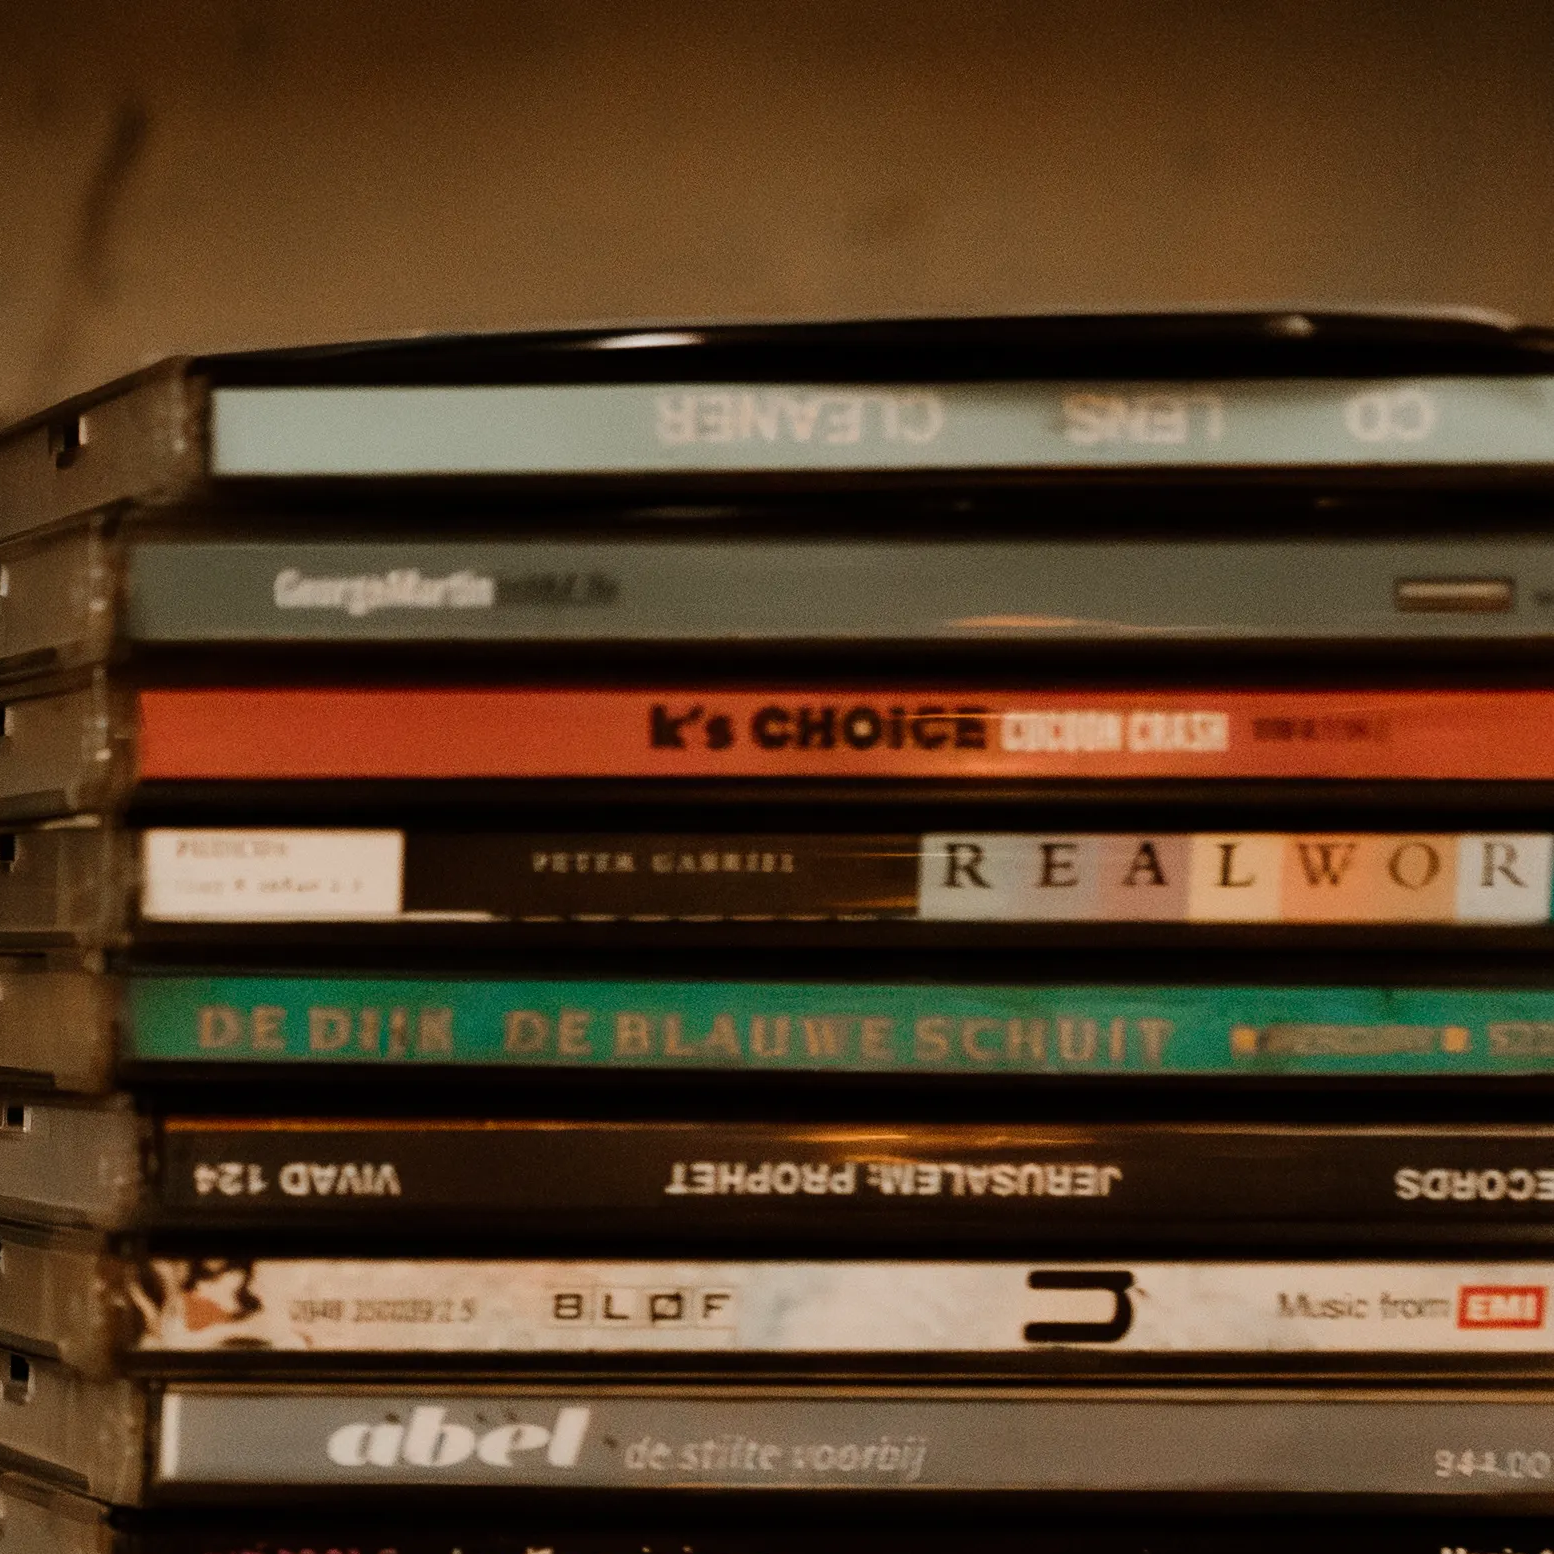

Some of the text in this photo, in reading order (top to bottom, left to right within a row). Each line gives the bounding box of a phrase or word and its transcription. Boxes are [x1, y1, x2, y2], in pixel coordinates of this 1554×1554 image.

[654, 394, 945, 444] CLEANER
[198, 1004, 287, 1050] DE
[503, 1008, 593, 1055] DE
[613, 1010, 894, 1061] BLAUWE
[913, 1015, 1175, 1067] SCHUIT
[665, 1160, 856, 1196] PROPHET
[1277, 1291, 1365, 1322] Music
[1379, 1291, 1451, 1321] from
[326, 1405, 591, 1469] abel
[624, 1436, 669, 1472] de
